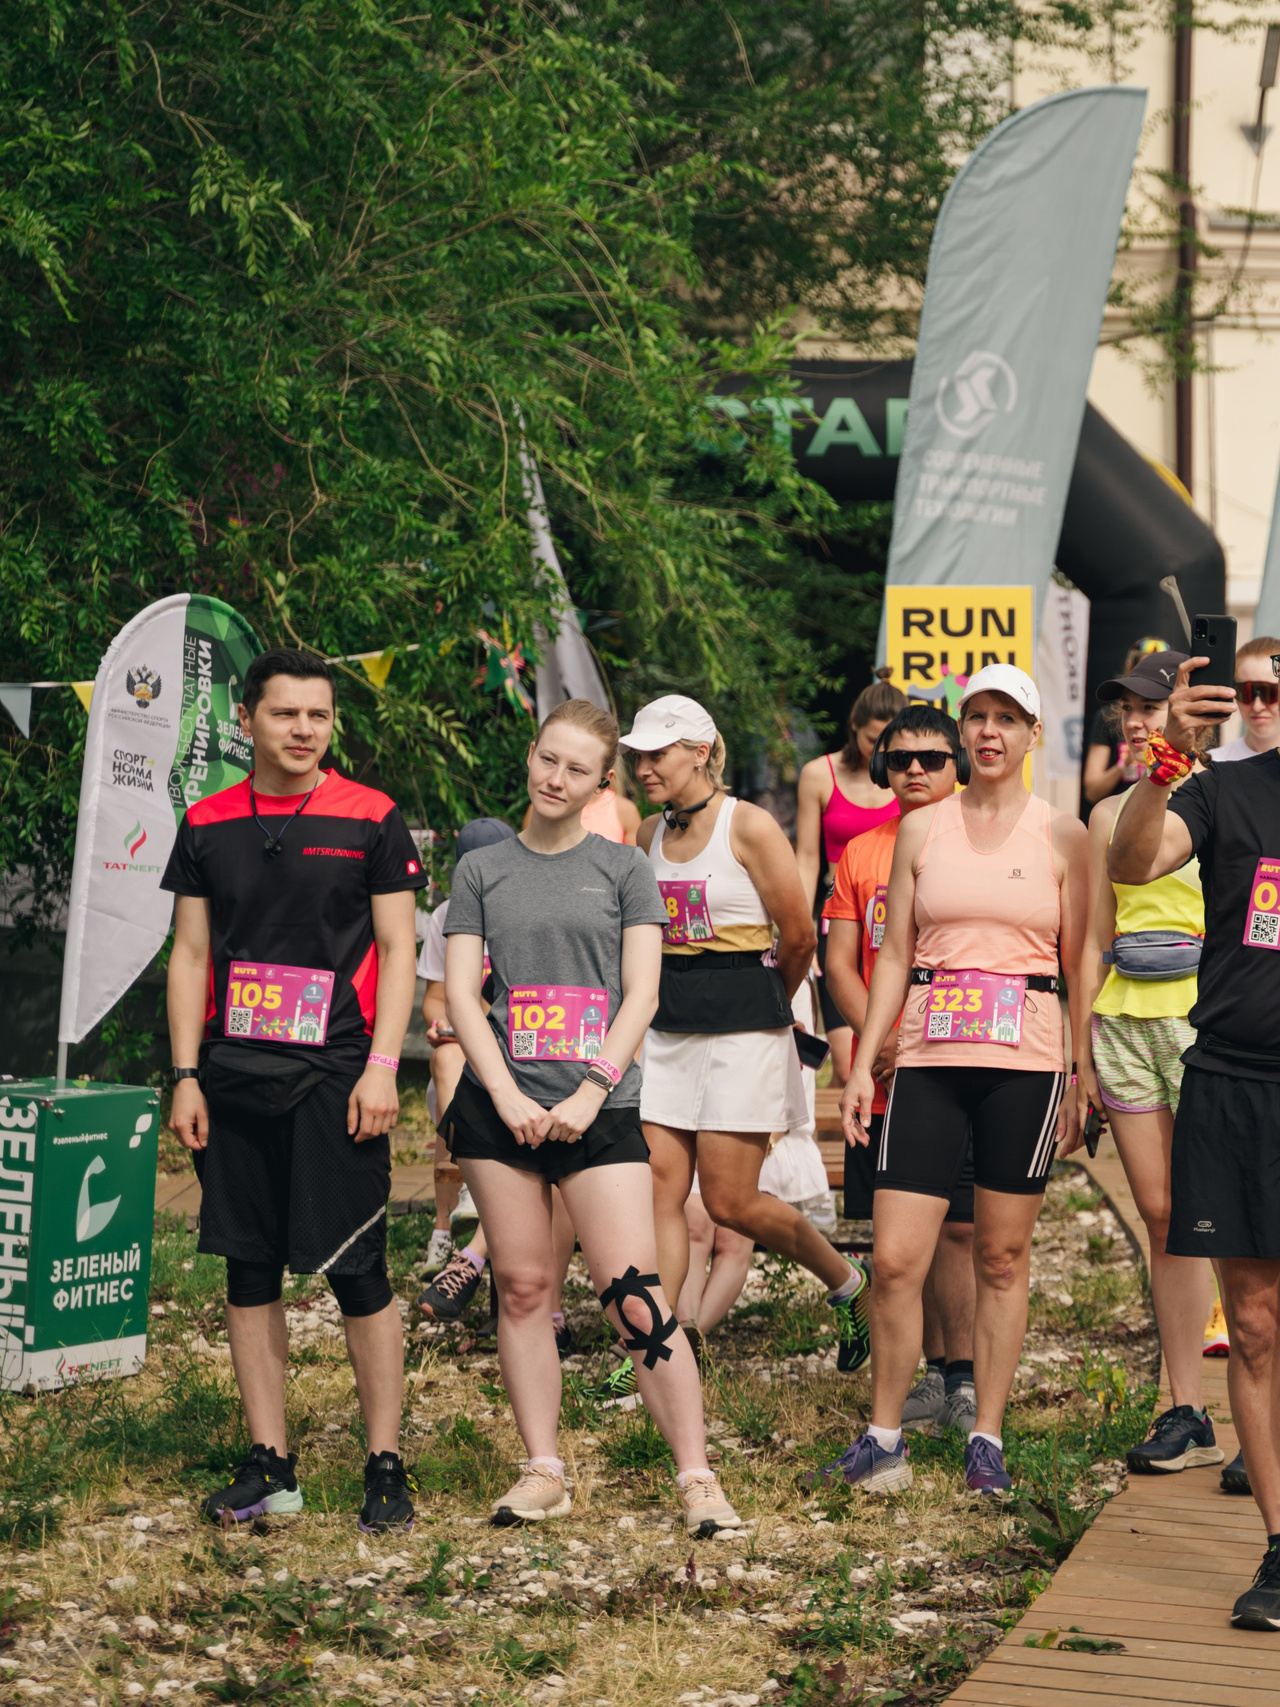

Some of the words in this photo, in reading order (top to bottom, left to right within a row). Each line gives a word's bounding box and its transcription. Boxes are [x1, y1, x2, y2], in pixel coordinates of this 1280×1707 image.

[902, 608, 1015, 637] RUN
[178, 634, 197, 755] БЕСПЛАТНЫЕ
[113, 749, 147, 766] СПОРТ
[112, 761, 152, 780] НОРМА
[112, 774, 154, 792] ЖИЗНИ
[302, 847, 365, 859] #MTSRUNNING
[103, 862, 162, 874] TATNEFT
[664, 897, 679, 918] 8
[874, 901, 886, 924] 0
[230, 981, 283, 1010] 105
[310, 986, 317, 995] 1
[513, 990, 538, 998] RUTS
[1006, 990, 1013, 999] 1
[929, 988, 983, 1013] 323
[510, 1005, 566, 1030] 102
[589, 1008, 596, 1017] 1
[53, 1132, 108, 1145] #зеленыйфитнес
[50, 1242, 141, 1283] ЗЕЛЕНЫЙ
[52, 1278, 134, 1312] ФИТНЕС
